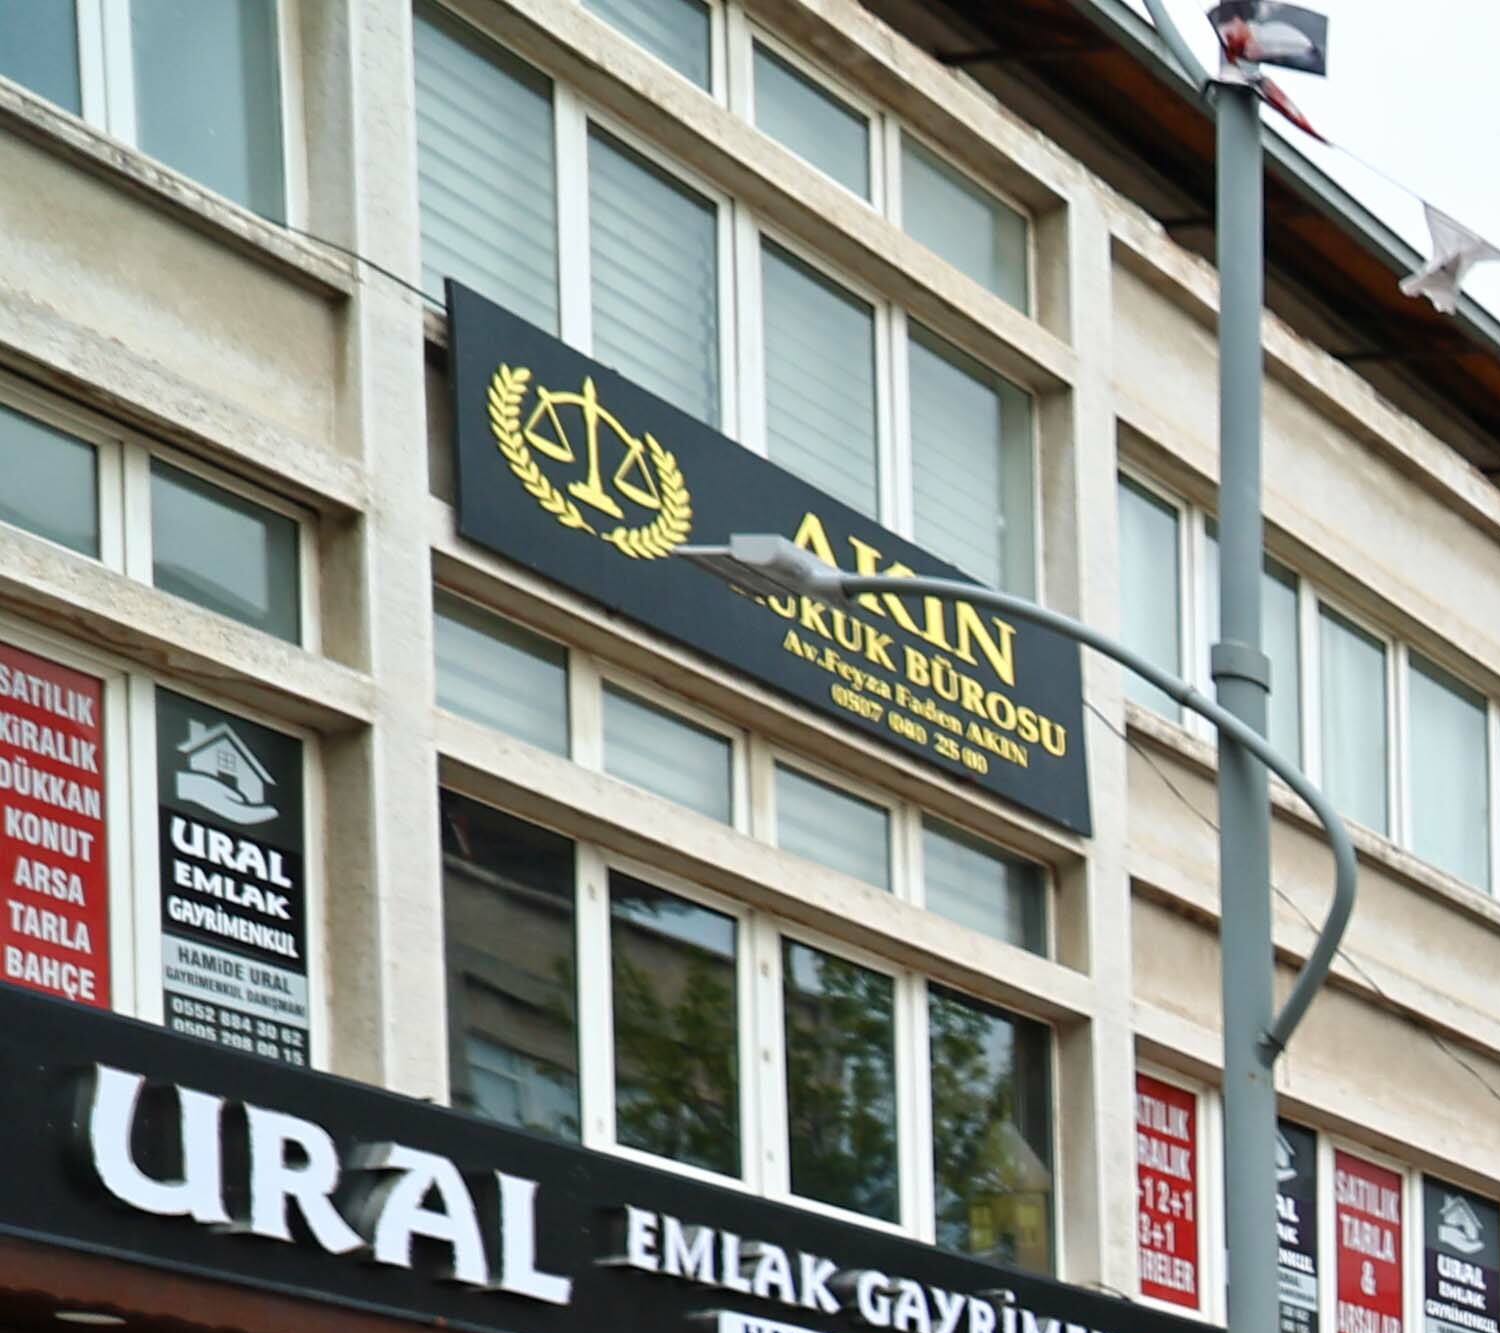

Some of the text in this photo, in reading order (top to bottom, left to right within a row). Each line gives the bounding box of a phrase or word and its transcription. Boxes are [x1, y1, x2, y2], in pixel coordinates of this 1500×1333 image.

[794, 511, 1016, 687] AKIN
[0, 664, 96, 727] SATILIK
[903, 643, 1067, 758] BÜROSU
[967, 718, 1030, 769] AKIN
[4, 806, 95, 862] KONUT
[170, 814, 293, 889] URAL
[13, 855, 86, 907] ARSA
[173, 858, 292, 920] EMLAK
[7, 901, 93, 954] TARLA
[167, 894, 300, 960] GAYRİMENKUL
[5, 950, 97, 1001] BAHÇE
[249, 964, 292, 995] URAL
[88, 1062, 574, 1305] URAL
[624, 1204, 841, 1314] EMLAK
[1340, 1212, 1396, 1265] TARLA
[1360, 1258, 1378, 1298] &
